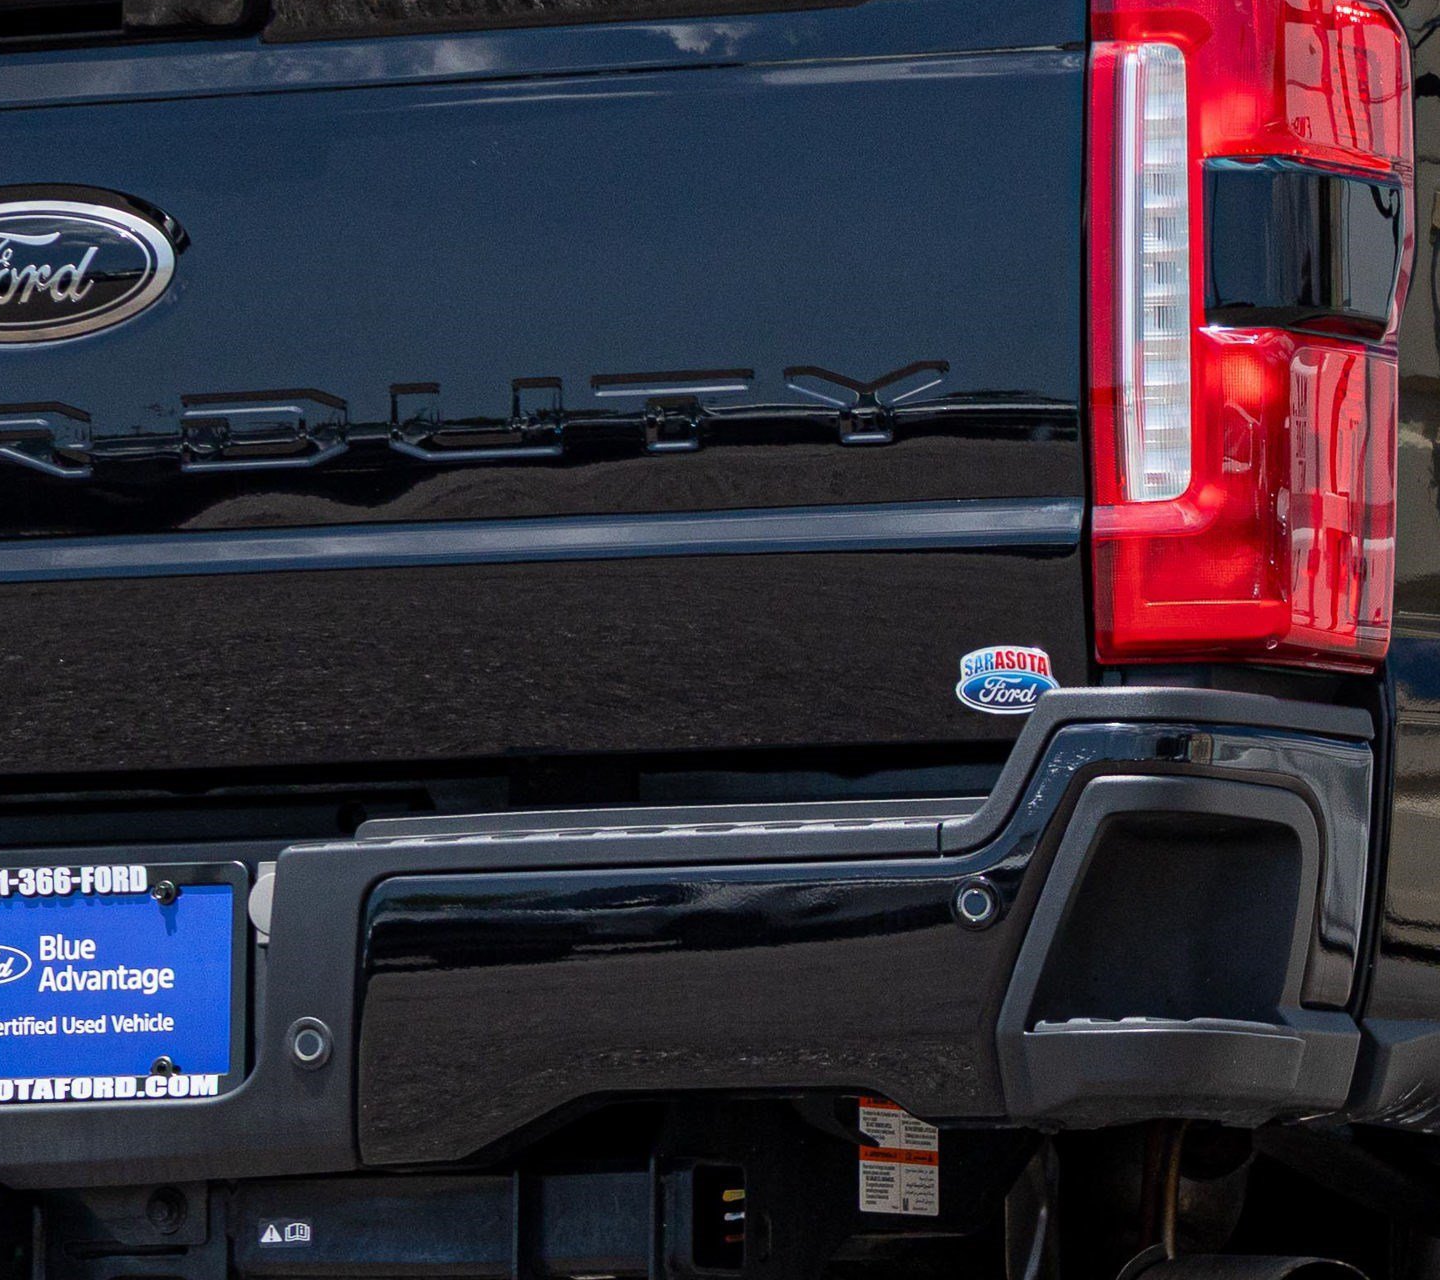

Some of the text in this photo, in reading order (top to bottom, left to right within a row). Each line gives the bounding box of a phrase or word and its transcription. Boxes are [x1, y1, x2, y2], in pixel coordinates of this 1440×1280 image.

[180, 360, 951, 472] DUTY
[965, 650, 1049, 676] SARASOTA
[979, 677, 1037, 703] Ford
[39, 934, 96, 961] Blue
[38, 966, 175, 995] Advantage
[62, 1016, 107, 1035] Used
[111, 1013, 174, 1033] Vehicle
